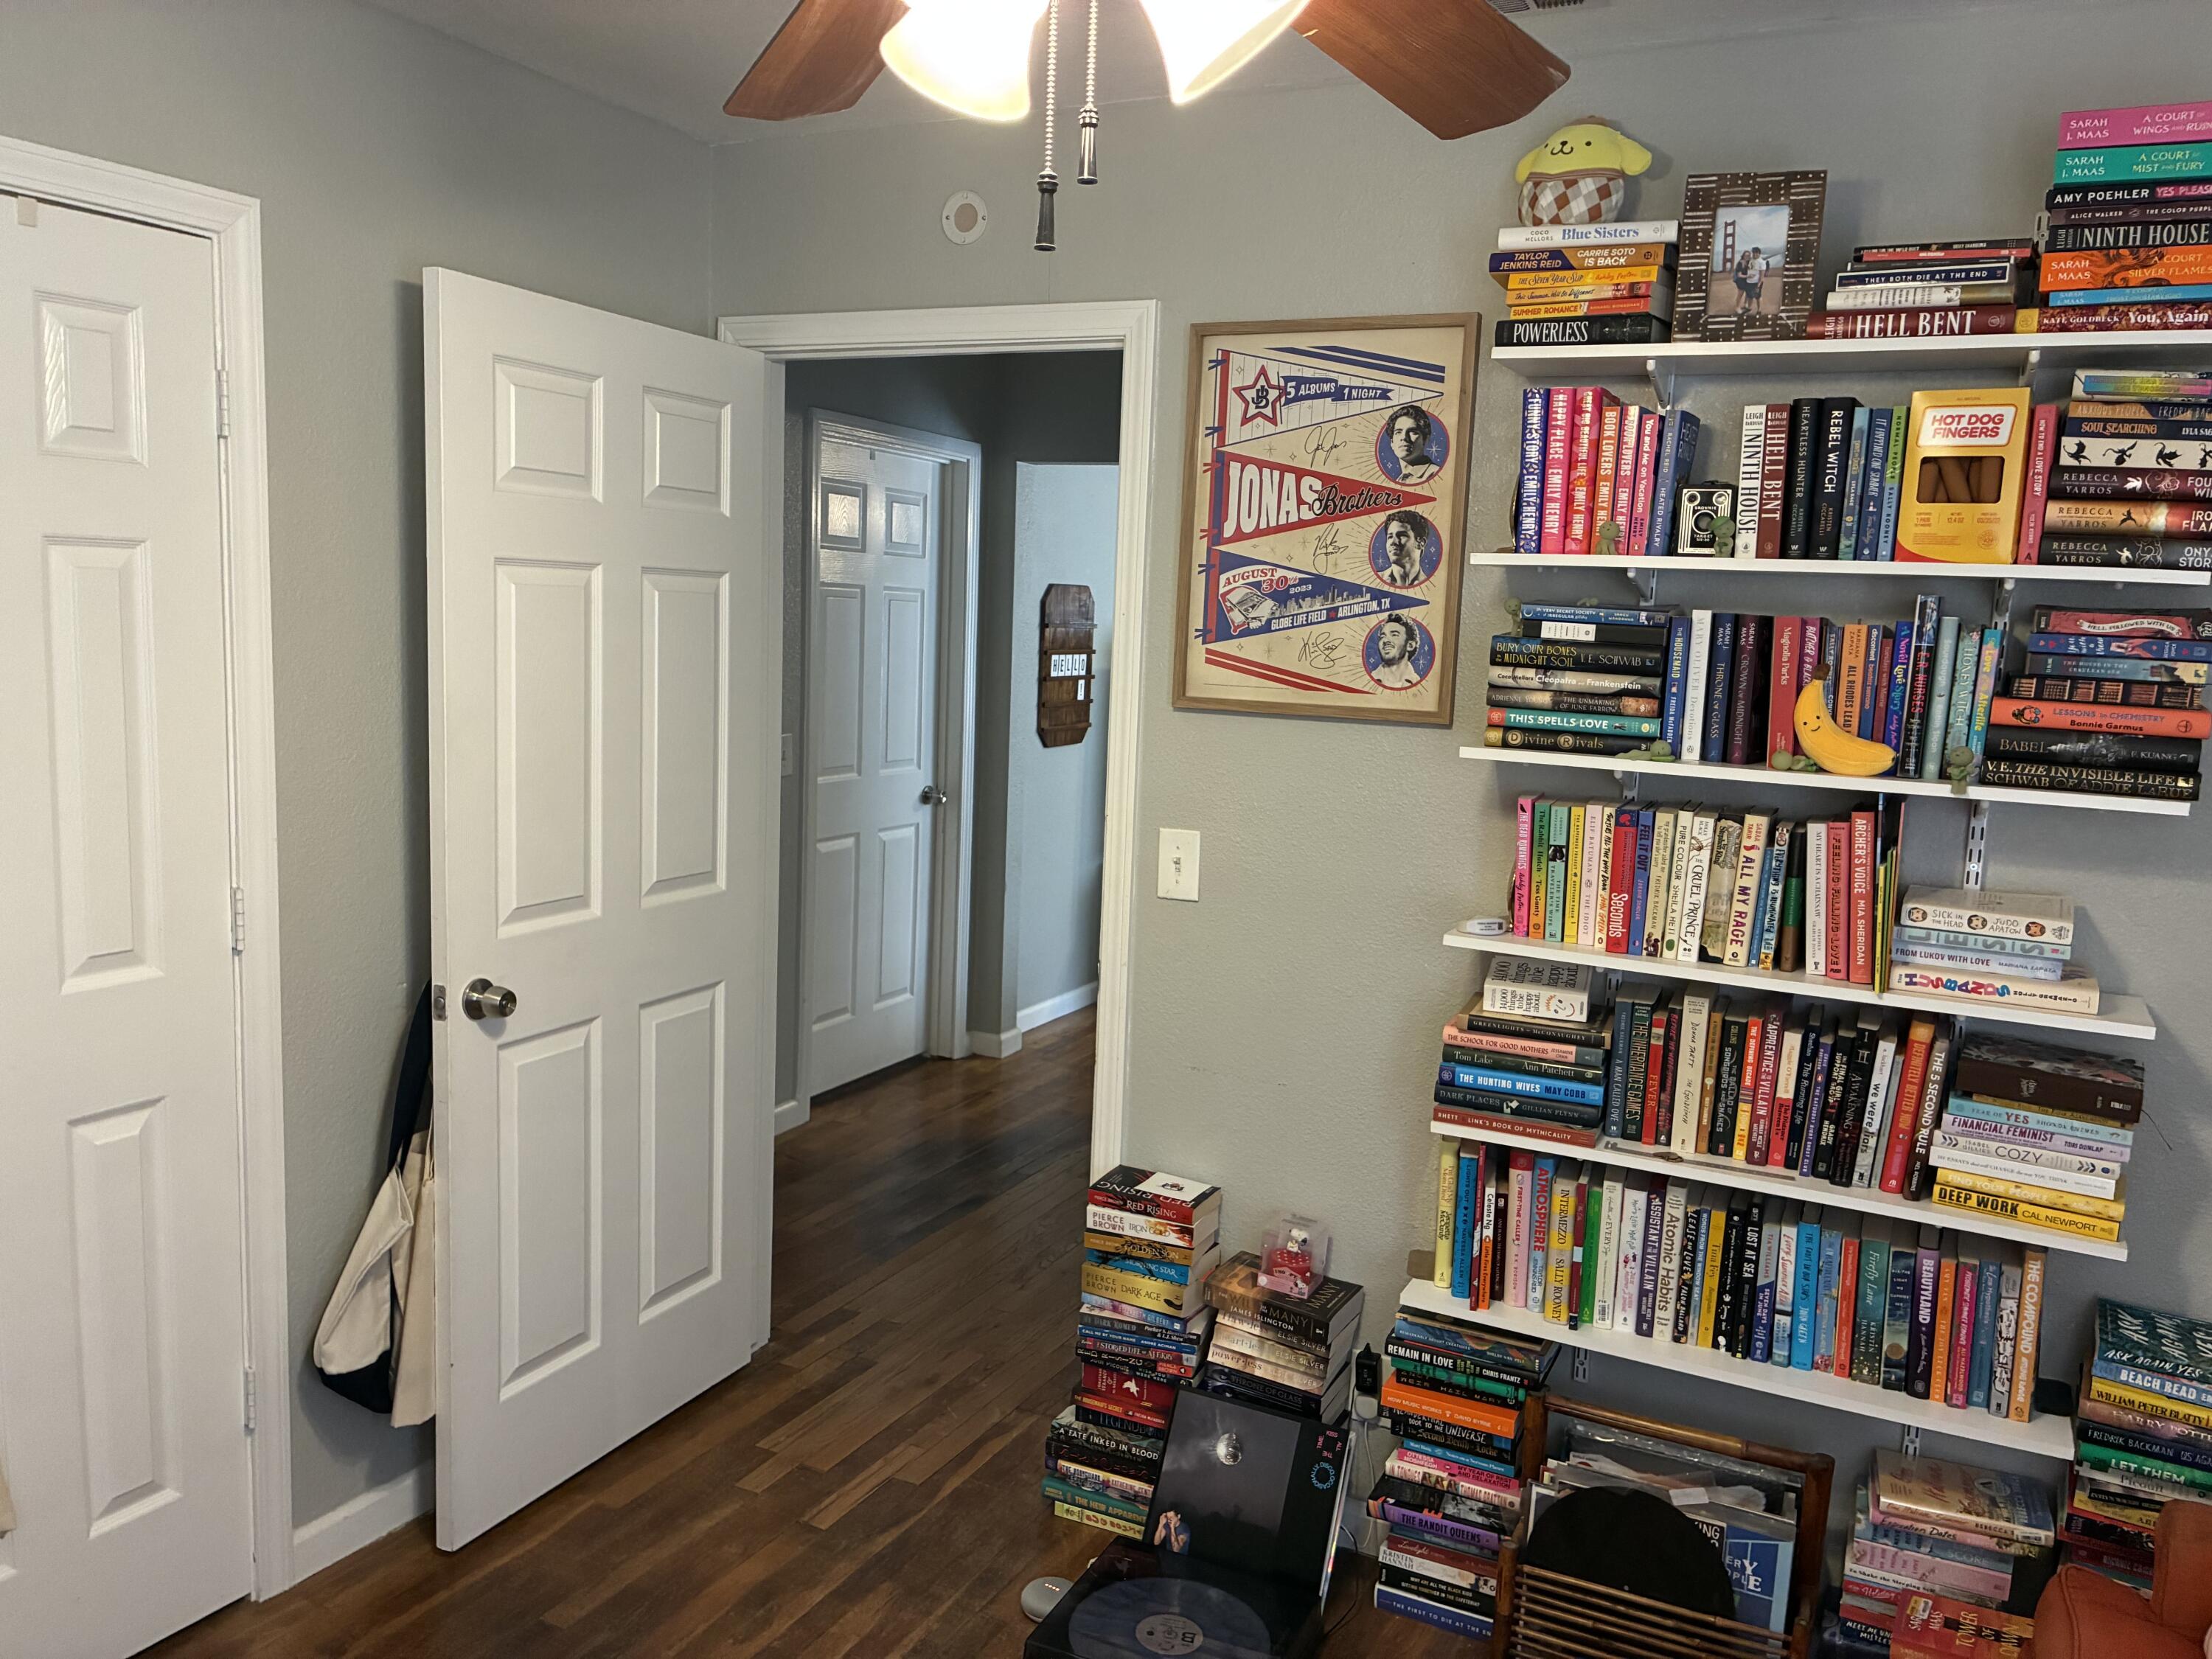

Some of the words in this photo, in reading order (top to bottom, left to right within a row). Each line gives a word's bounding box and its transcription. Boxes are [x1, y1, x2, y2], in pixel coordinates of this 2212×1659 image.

[2070, 118, 2107, 128] SARAH
[2155, 111, 2195, 122] COURT
[2077, 130, 2109, 139] MAAS
[2133, 125, 2169, 135] WINGS
[2066, 156, 2103, 165] SARAH
[2132, 164, 2158, 173] MIST
[2175, 161, 2205, 171] FURY
[2073, 167, 2105, 176] MAAS
[2054, 193, 2082, 204] AMY
[2087, 189, 2149, 202] POEHLER
[1562, 227, 1591, 240] Blue
[1594, 226, 1639, 239] Sisters
[2082, 226, 2141, 248] NINTH
[2147, 223, 2210, 245] HOUSE
[1514, 252, 1549, 261] TAYLOR
[1577, 248, 1609, 258] CARRIE
[1610, 248, 1635, 257] SOTO
[1595, 256, 1626, 266] BACK
[1499, 260, 1536, 270] JENKINS
[1539, 259, 1562, 268] REID
[1513, 307, 1541, 316] SUMMER
[1544, 305, 1578, 313] ROMANCE
[2128, 312, 2161, 324] You,
[2164, 310, 2209, 326] Again
[1514, 322, 1588, 343] POWERLESS
[1855, 313, 1910, 338] HELL
[1918, 310, 1976, 336] BENT
[1287, 381, 1295, 397] 5
[1298, 382, 1336, 397] ALBUMS
[1344, 388, 1348, 399] 1
[1351, 389, 1382, 400] NIGHT
[1527, 397, 1542, 429] FUNNY
[1932, 414, 1966, 426] HOT
[1967, 414, 2004, 425] DOG
[1829, 409, 1844, 448] REBEL
[1933, 426, 2000, 439] FINGERS
[2081, 422, 2107, 434] SOUL
[2106, 422, 2157, 434] SEARCHING
[1526, 430, 1541, 465] STORY
[1764, 432, 1785, 473] HELL
[1742, 433, 1762, 485] NINTH
[1823, 451, 1840, 493] WITCH
[2063, 473, 2118, 482] REBECCA
[1523, 474, 1537, 504] EMILY
[2066, 485, 2112, 494] YARROS
[1223, 462, 1324, 538] JONAS
[1312, 482, 1402, 516] Brothers
[1761, 479, 1781, 521] BENT
[1521, 504, 1536, 538] HENRY
[1738, 487, 1760, 535] HOUSE
[2052, 542, 2107, 552] REBECCA
[2055, 554, 2101, 563] YARROS
[1222, 568, 1277, 588] AUGUST
[1290, 585, 1312, 594] 2023
[1271, 615, 1291, 630] GLOBE
[1293, 613, 1307, 627] LIFE
[1309, 611, 1326, 625] FIELD
[1338, 602, 1379, 618] ARLINGTON,
[1380, 599, 1391, 609] TX
[1497, 642, 1519, 653] BURY
[1523, 644, 1543, 654] OUR
[1546, 646, 1576, 656] BONES
[1782, 626, 1791, 660] Magnolia
[1053, 658, 1085, 672] HELLO
[1503, 654, 1547, 666] MIDNIGHT
[1551, 656, 1575, 667] SOIL
[1599, 655, 1641, 667] SCHWAB
[1536, 675, 1576, 686] Cleopatra
[1586, 678, 1641, 690] Frankenstein
[1781, 661, 1789, 685] Parks
[1509, 714, 1534, 723] THIS
[1537, 716, 1576, 726] SPELLS
[1579, 719, 1608, 729] LOVE
[2070, 720, 2103, 729] Bonnie
[2106, 721, 2143, 731] Garmus
[2000, 740, 2047, 754] BABEL
[2050, 766, 2134, 783] INVISIBLE
[2138, 773, 2175, 787] LIFE
[1854, 818, 1867, 864] ARCHER'S
[1674, 846, 1685, 880] COLOUR
[1739, 855, 1756, 880] ALL
[1689, 865, 1704, 898] CRUEL
[1854, 866, 1865, 894] VOICE
[1735, 886, 1751, 906] MY
[1684, 897, 1700, 938] PRINCE
[1729, 909, 1747, 947] RAGE
[1856, 919, 1865, 966] SHERIDAN
[1896, 947, 1918, 958] FROM
[1919, 950, 1945, 961] LUKOV
[1947, 953, 1968, 964] WITH
[1970, 956, 1990, 967] LOVE
[1904, 973, 2010, 998] HUSBANDS
[1460, 1036, 1484, 1045] SCHOOL
[1486, 1039, 1498, 1047] FOR
[1499, 1041, 1518, 1050] GOOD
[1520, 1045, 1548, 1054] MOTHERS
[1454, 1051, 1472, 1061] Tom
[1475, 1054, 1492, 1065] Lake
[1522, 1062, 1539, 1072] Ann
[1542, 1065, 1574, 1077] Patchett
[1478, 1077, 1512, 1089] HUNTING
[1516, 1082, 1540, 1093] WIVES
[1545, 1085, 1562, 1096] MAY
[1565, 1089, 1585, 1099] COBB
[1921, 1082, 1939, 1130] SECOND
[1492, 1121, 1512, 1130] BOOK
[1526, 1127, 1571, 1140] MYTHICALITY
[1952, 1117, 2004, 1134] FINANCIAL
[2006, 1127, 2056, 1143] FEMINIST
[1916, 1127, 1930, 1155] RULE
[1995, 1146, 2044, 1164] COZY
[1127, 1200, 1144, 1211] RED
[1147, 1204, 1177, 1219] RISING
[1534, 1167, 1549, 1252] ATMOSPHERE
[1938, 1187, 1972, 1204] DEEP
[1976, 1195, 2019, 1216] WORK
[1093, 1212, 1124, 1225] PIERCE
[1093, 1220, 1124, 1232] BROWN
[1557, 1189, 1570, 1245] INTERMEZZO
[2022, 1210, 2043, 1222] CAL
[2045, 1215, 2097, 1232] NEWPORT
[1663, 1214, 1681, 1264] Atomic
[1555, 1258, 1565, 1284] SALLY
[1121, 1284, 1142, 1298] DARK
[1144, 1290, 1161, 1302] AGE
[1658, 1265, 1675, 1312] Habits
[1919, 1258, 1935, 1324] BEAUTYLAND
[1551, 1286, 1563, 1321] ROONEY
[2021, 1283, 2038, 1354] COMPOUND
[1388, 1344, 1419, 1360] REMAIN
[1433, 1356, 1453, 1368] LOVE
[1483, 1369, 1499, 1379] CHRIS
[1500, 1373, 1520, 1383] FRANTZ
[2120, 1369, 2161, 1390] BEACH
[2165, 1381, 2197, 1400] READ
[1068, 1430, 1086, 1440] FATE
[1091, 1433, 1116, 1448] INKED
[1132, 1447, 1158, 1460] BLOOD
[1419, 1518, 1447, 1534] BANDIT
[1450, 1527, 1481, 1543] QUEENS
